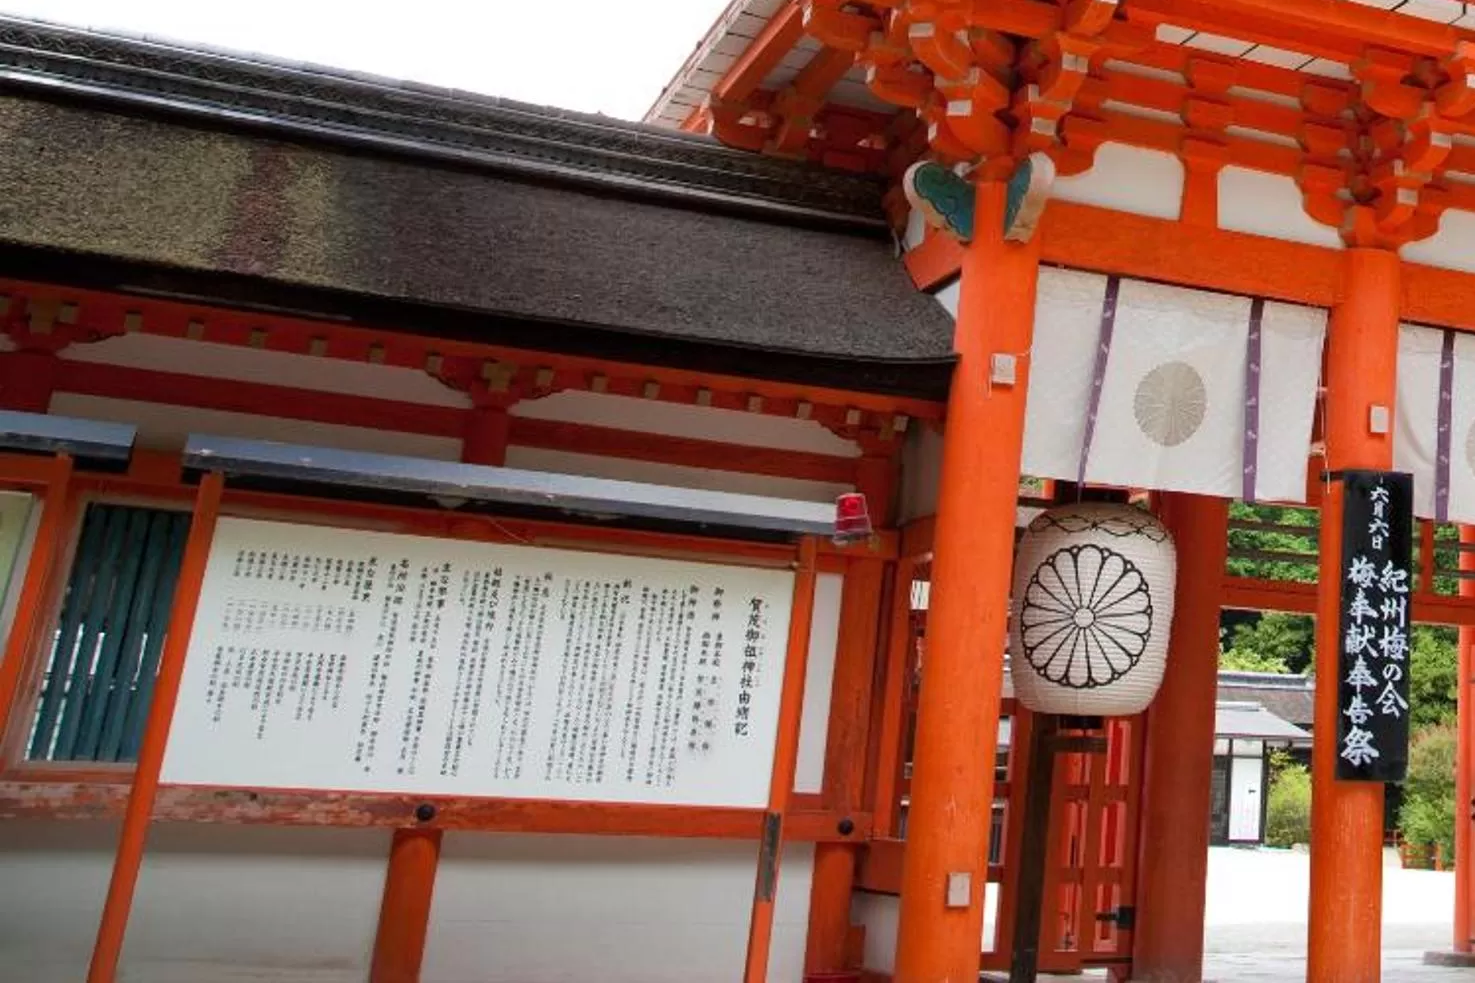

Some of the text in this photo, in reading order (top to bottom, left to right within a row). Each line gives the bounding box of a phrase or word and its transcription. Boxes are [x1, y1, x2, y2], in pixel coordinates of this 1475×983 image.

[1368, 486, 1390, 550] 六月六日
[1341, 555, 1380, 767] 梅奉献奉告祭
[1377, 559, 1410, 718] 紀州梅の会
